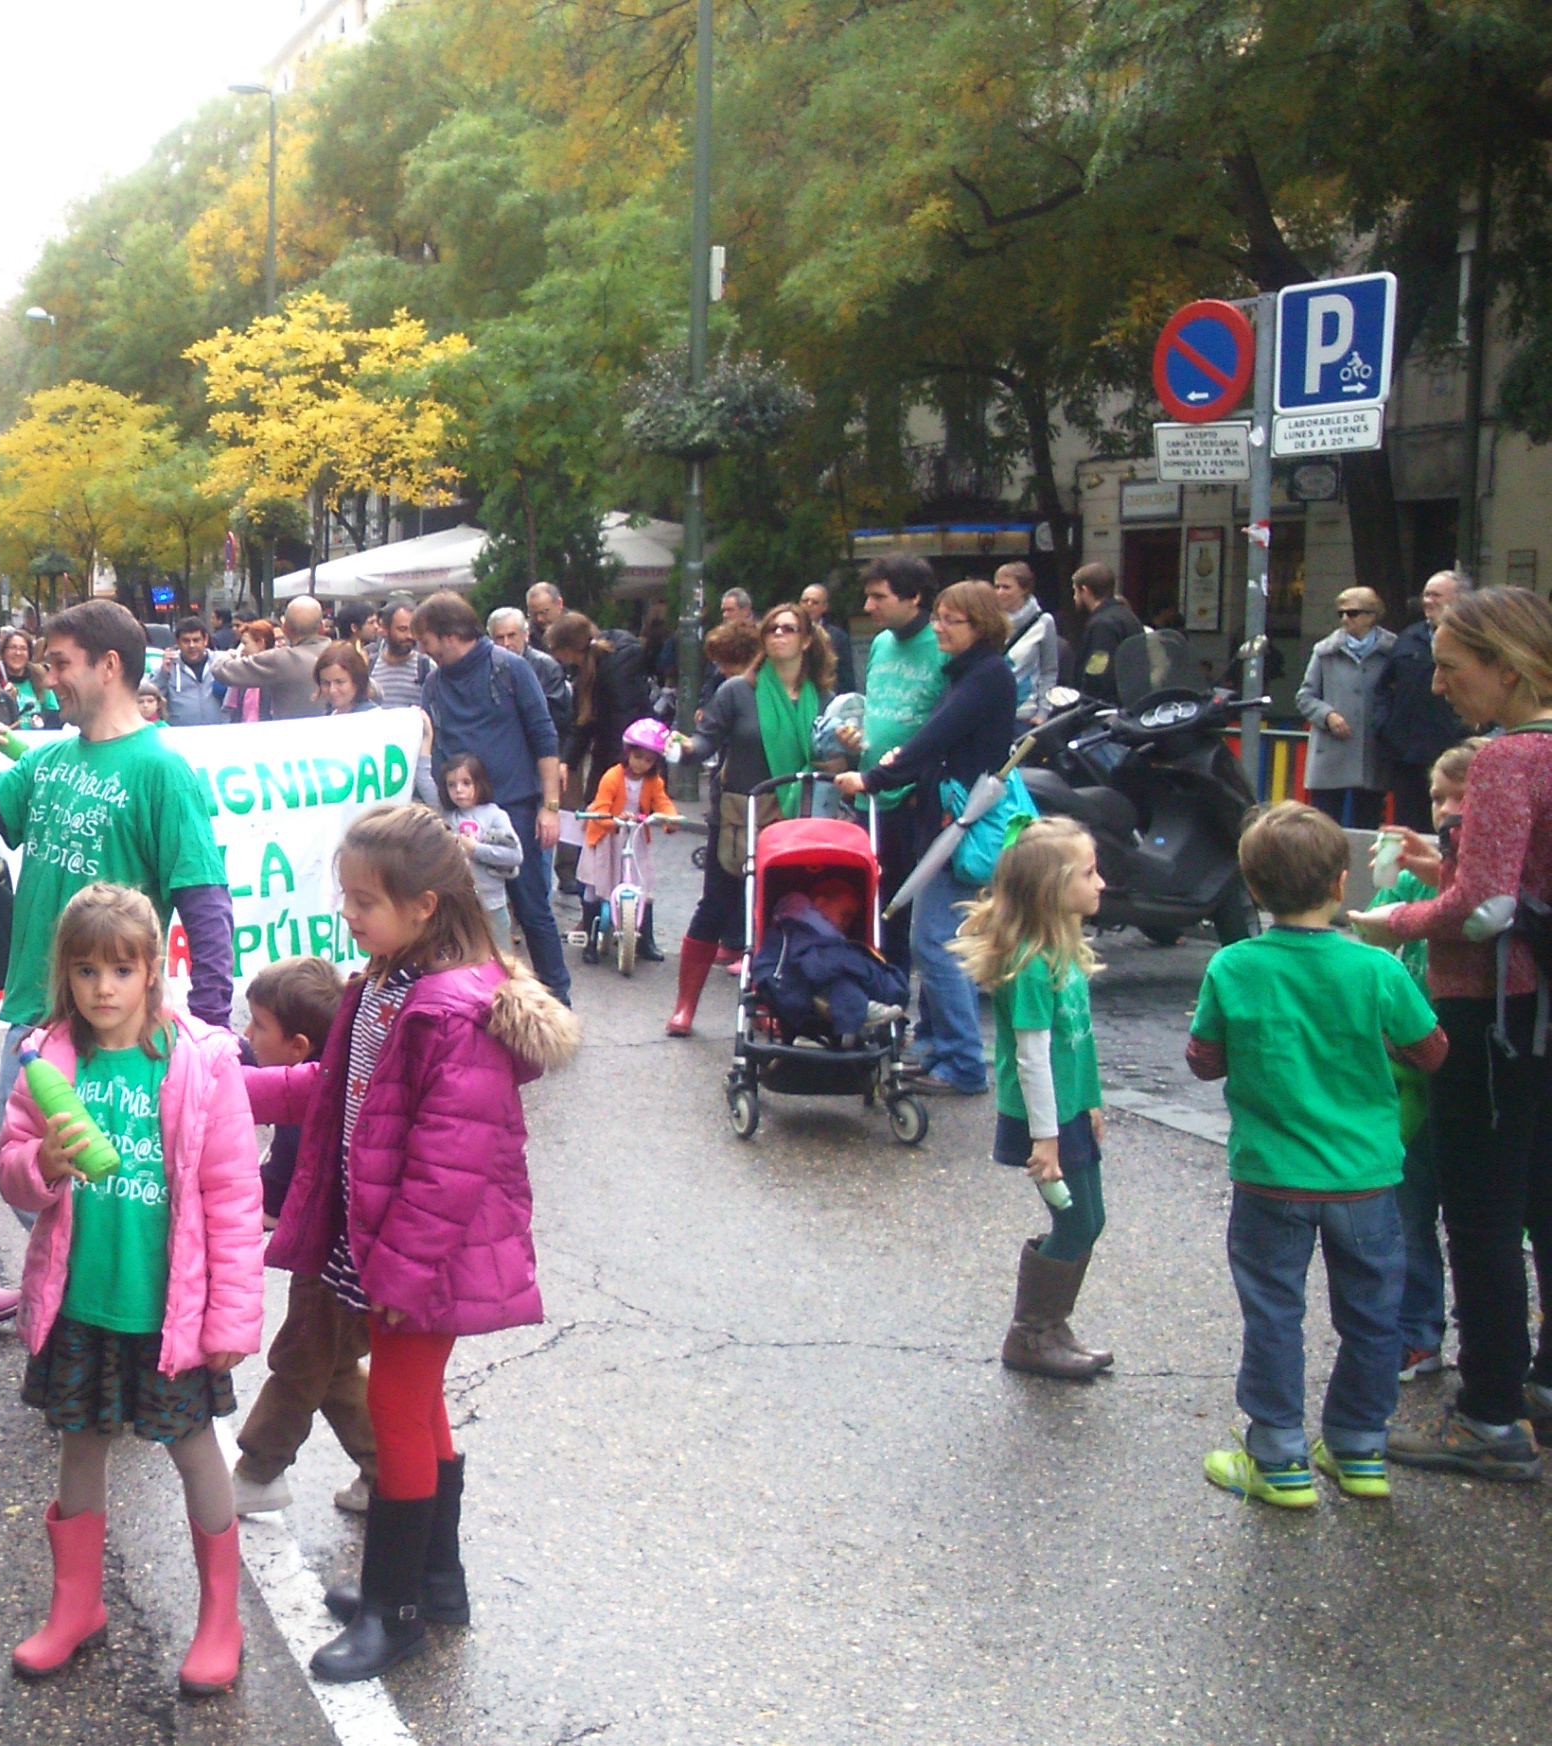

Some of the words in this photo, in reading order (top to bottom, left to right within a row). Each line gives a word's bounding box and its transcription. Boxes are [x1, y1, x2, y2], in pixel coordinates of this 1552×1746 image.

[1304, 294, 1355, 395] P
[1283, 430, 1314, 440] LUNES
[1318, 428, 1325, 437] A
[1328, 424, 1370, 436] VIERNES
[1288, 415, 1349, 430] LABORABLES
[1353, 413, 1366, 423] DE
[1294, 440, 1306, 449] DE
[1320, 438, 1327, 446] A
[1331, 437, 1344, 446] 20
[1210, 459, 1245, 467] FESTIVOS
[196, 744, 409, 816] IGNIDAD
[217, 841, 295, 898] LA
[232, 908, 371, 978] PÚBLI
